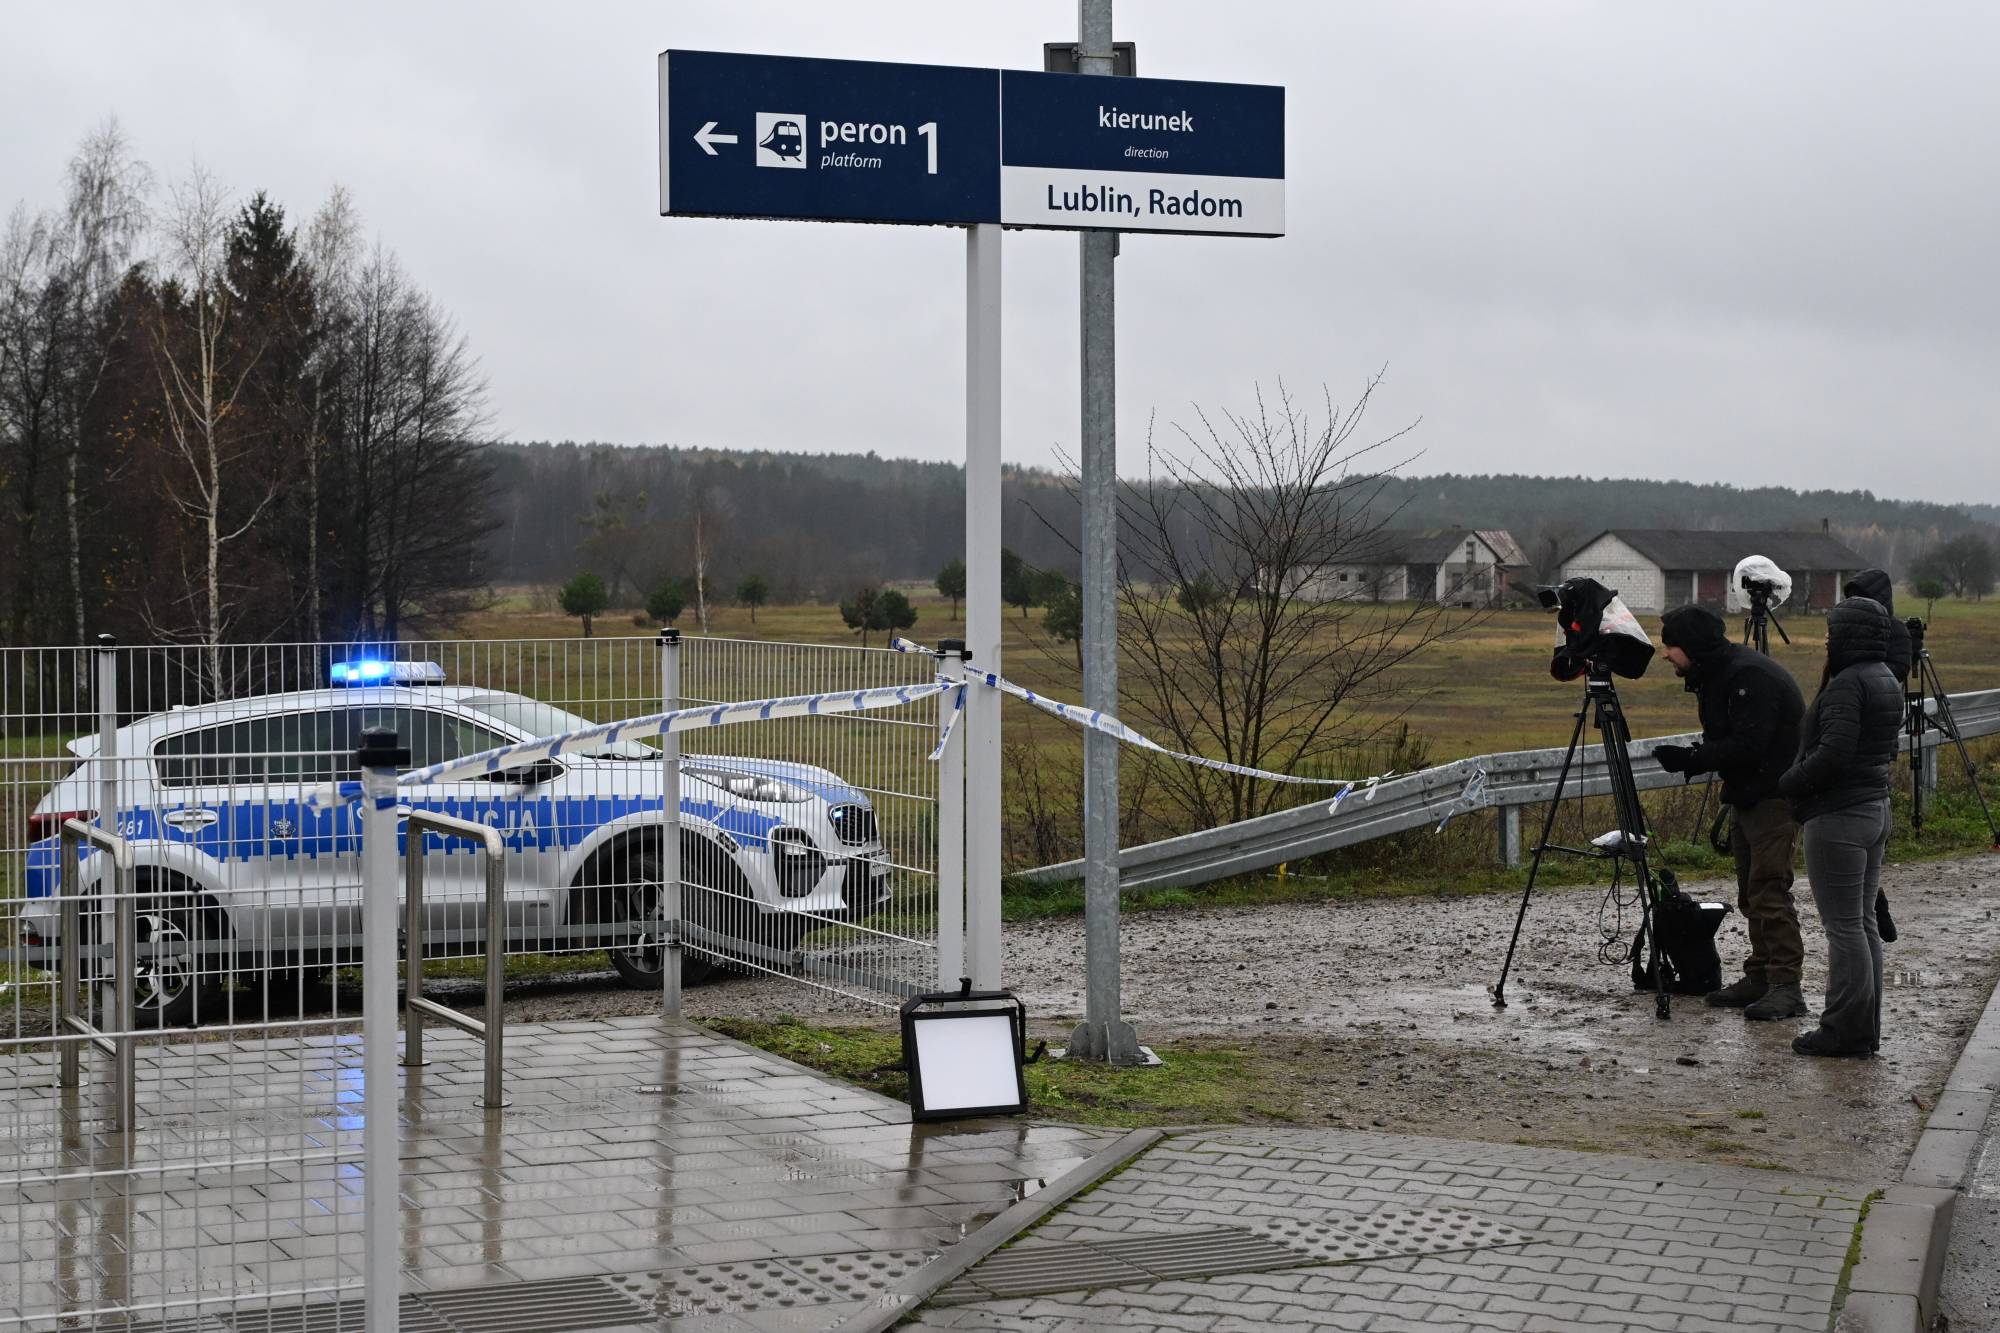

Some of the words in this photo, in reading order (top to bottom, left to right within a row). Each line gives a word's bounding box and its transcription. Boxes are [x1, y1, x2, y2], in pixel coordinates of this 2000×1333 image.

[1099, 105, 1194, 133] kierunek
[820, 121, 906, 149] peron
[917, 121, 938, 175] 1
[820, 151, 883, 170] platform
[1124, 145, 1169, 159] direction
[1047, 184, 1141, 218] Lublin,
[1149, 188, 1243, 218] Radom
